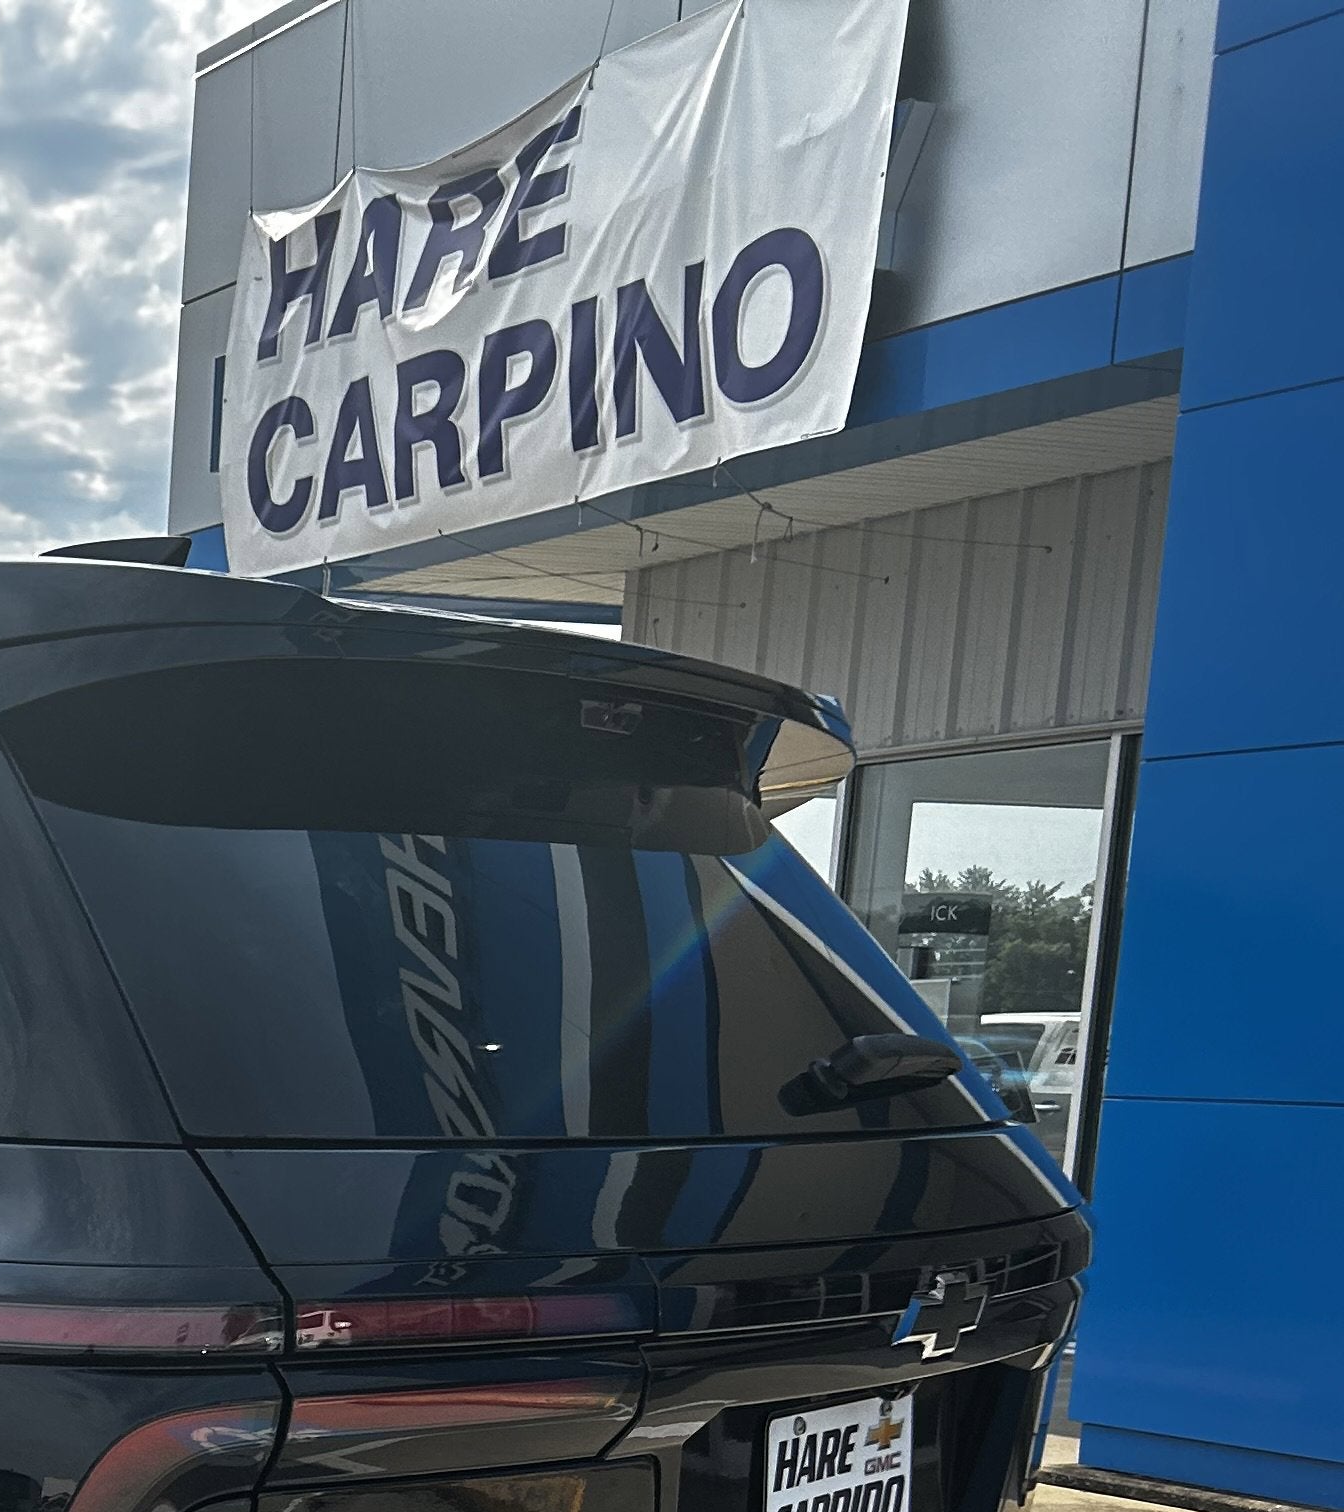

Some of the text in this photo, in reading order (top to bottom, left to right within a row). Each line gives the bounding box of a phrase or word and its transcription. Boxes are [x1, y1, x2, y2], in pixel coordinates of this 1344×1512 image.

[257, 105, 581, 362] HARE
[248, 227, 825, 535] CARPINO
[773, 1423, 859, 1493] HARE
[864, 1451, 902, 1477] GMC
